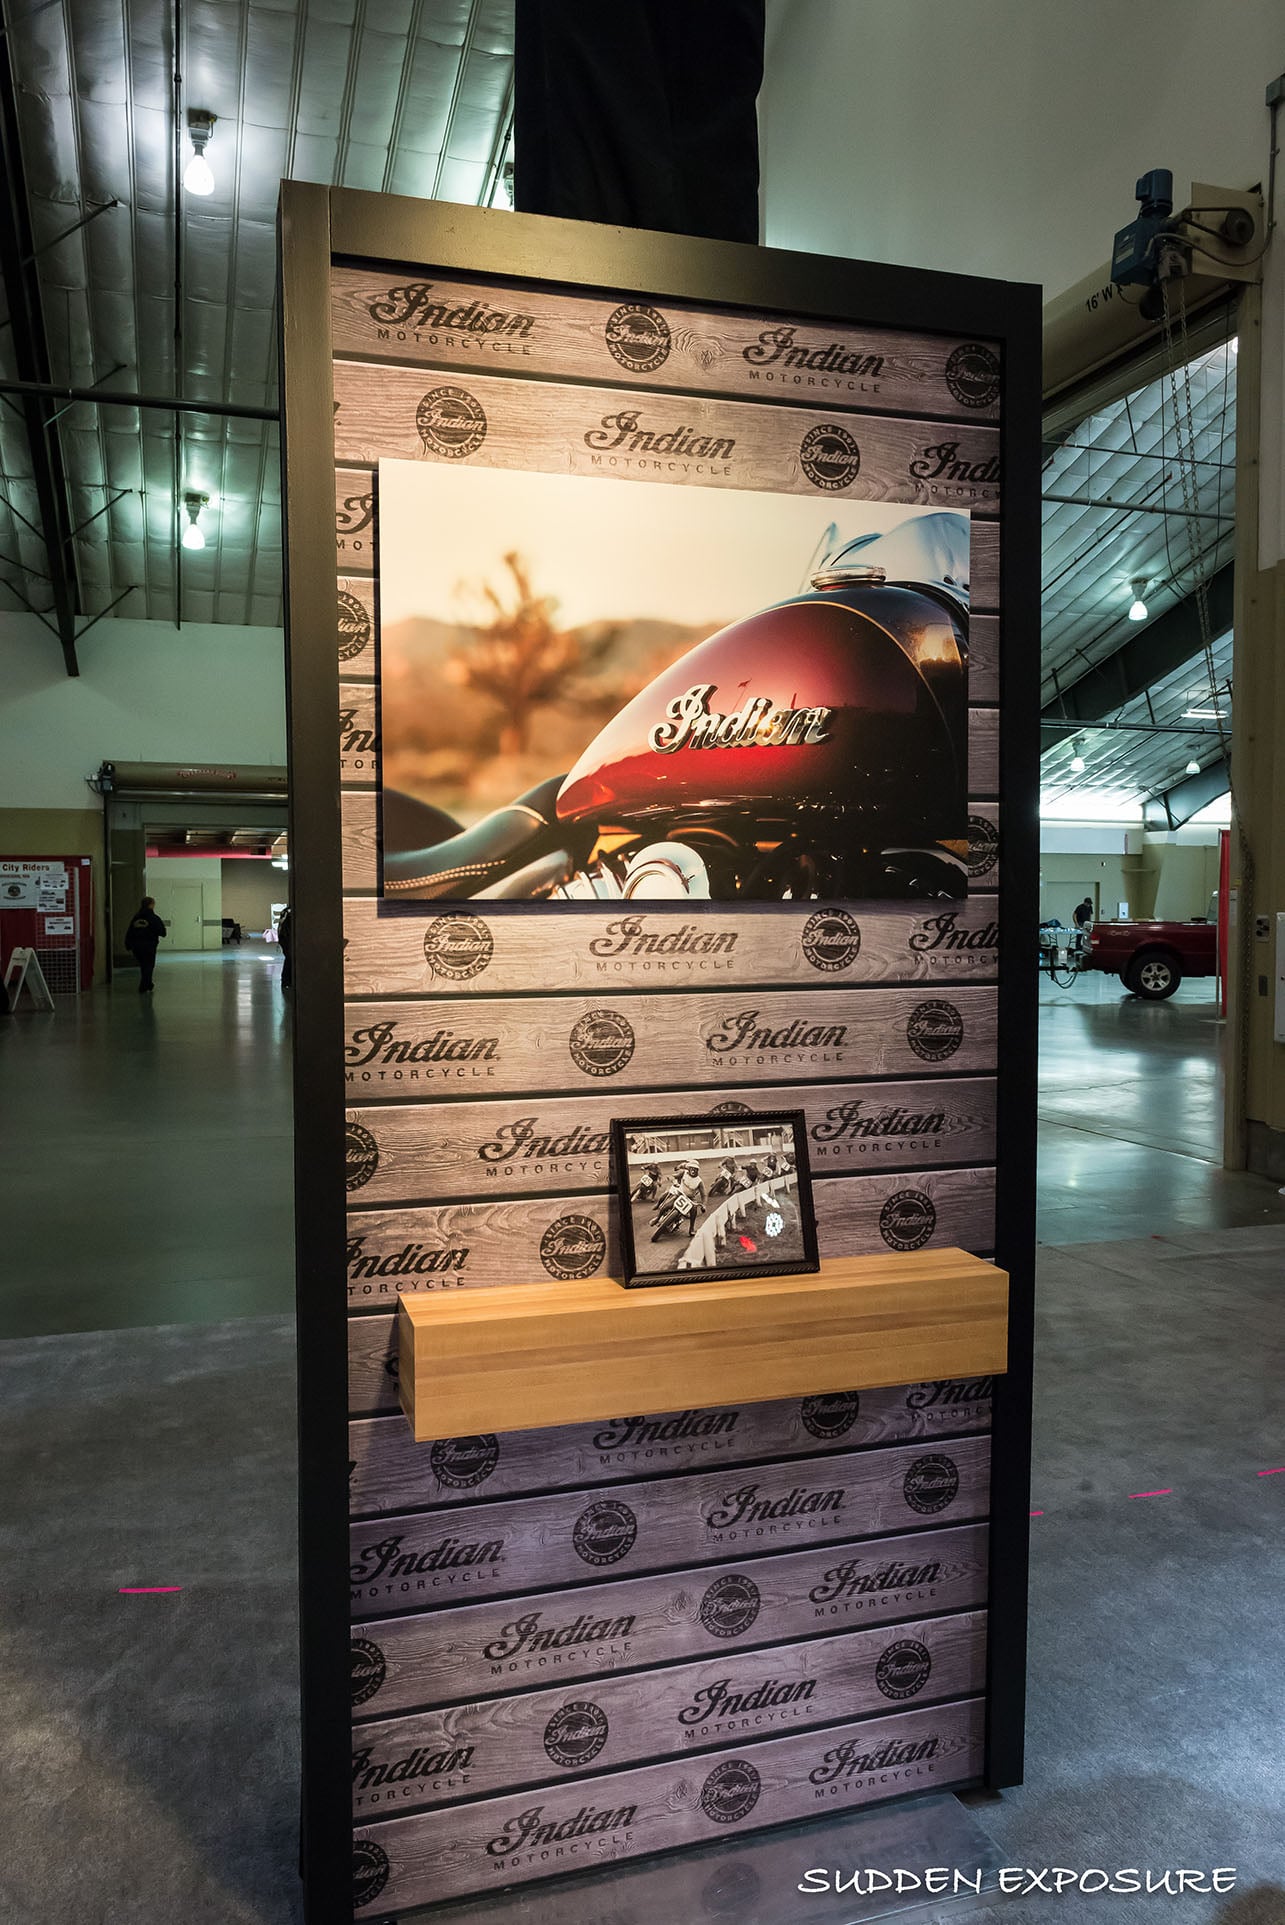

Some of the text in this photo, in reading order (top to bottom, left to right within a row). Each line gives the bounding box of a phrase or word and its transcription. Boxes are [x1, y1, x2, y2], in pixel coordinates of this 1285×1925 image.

[368, 283, 536, 339] Indian
[613, 305, 640, 325] SINCE
[377, 329, 531, 356] MOTORCYCLE
[742, 327, 885, 377] Indian
[609, 345, 669, 371] MOTORCYCLE
[749, 370, 881, 394] MOTORCYCLE
[423, 389, 454, 408] SINCE
[418, 408, 485, 431] Indian
[420, 430, 484, 457] MOTORCYCLE
[583, 411, 736, 460] Indian
[806, 426, 833, 443] SINCE
[591, 455, 731, 476] MOTORCYCLE
[801, 445, 858, 466] Indian
[803, 464, 858, 489] MOTORCYCLE
[648, 684, 831, 754] Indian
[2, 864, 19, 872] City
[807, 910, 834, 926] SINCE
[424, 934, 490, 952] Indian
[588, 915, 739, 957] Indian
[802, 928, 860, 947] Indian
[596, 959, 734, 972] MOTORCYCLE
[804, 947, 859, 971] MOTORCYCLE
[571, 1031, 634, 1049] Indian
[706, 1010, 849, 1053] Indian
[908, 1020, 961, 1037] Indian
[344, 1021, 500, 1068] Indian
[573, 1050, 633, 1075] MOTORCYCLE
[712, 1052, 843, 1067] MOTORCYCLE
[344, 1067, 495, 1083] MOTORCYCLE
[811, 1100, 946, 1142] Indian
[817, 1138, 942, 1156] MOTORCYCLE
[676, 1197, 689, 1211] 51
[546, 1217, 575, 1238] SINCE
[880, 1212, 935, 1229] Indian
[541, 1238, 605, 1256] Indian
[882, 1226, 933, 1249] MOTORCYCLE
[543, 1254, 603, 1279] MOTORCYCLE
[347, 1277, 465, 1295] TORCYCLE
[593, 1410, 740, 1449] Indian
[432, 1444, 496, 1465] Indian
[600, 1438, 735, 1465] MOTORCYCLE
[707, 1484, 845, 1529] Indian
[575, 1522, 635, 1542] Indian
[714, 1514, 842, 1542] MOTORCYCLE
[350, 1536, 505, 1585] Indian
[351, 1568, 500, 1599] MOTORCYCLE
[808, 1559, 941, 1604] Indian
[814, 1588, 937, 1617] MOTORCYCLE
[482, 1612, 636, 1661] Indian
[490, 1642, 632, 1675] MOTORCYCLE
[678, 1678, 817, 1725] Indian
[684, 1705, 814, 1739] MOTORCYCLE
[545, 1725, 607, 1746] Indian
[548, 1738, 604, 1765] MOTORCYCLE
[808, 1738, 939, 1786] Indian
[355, 1774, 471, 1806] TORCYCLE
[815, 1764, 936, 1799] MOTORCYCLE
[486, 1805, 639, 1857] Indian
[493, 1831, 634, 1871] MOTORCYCLE
